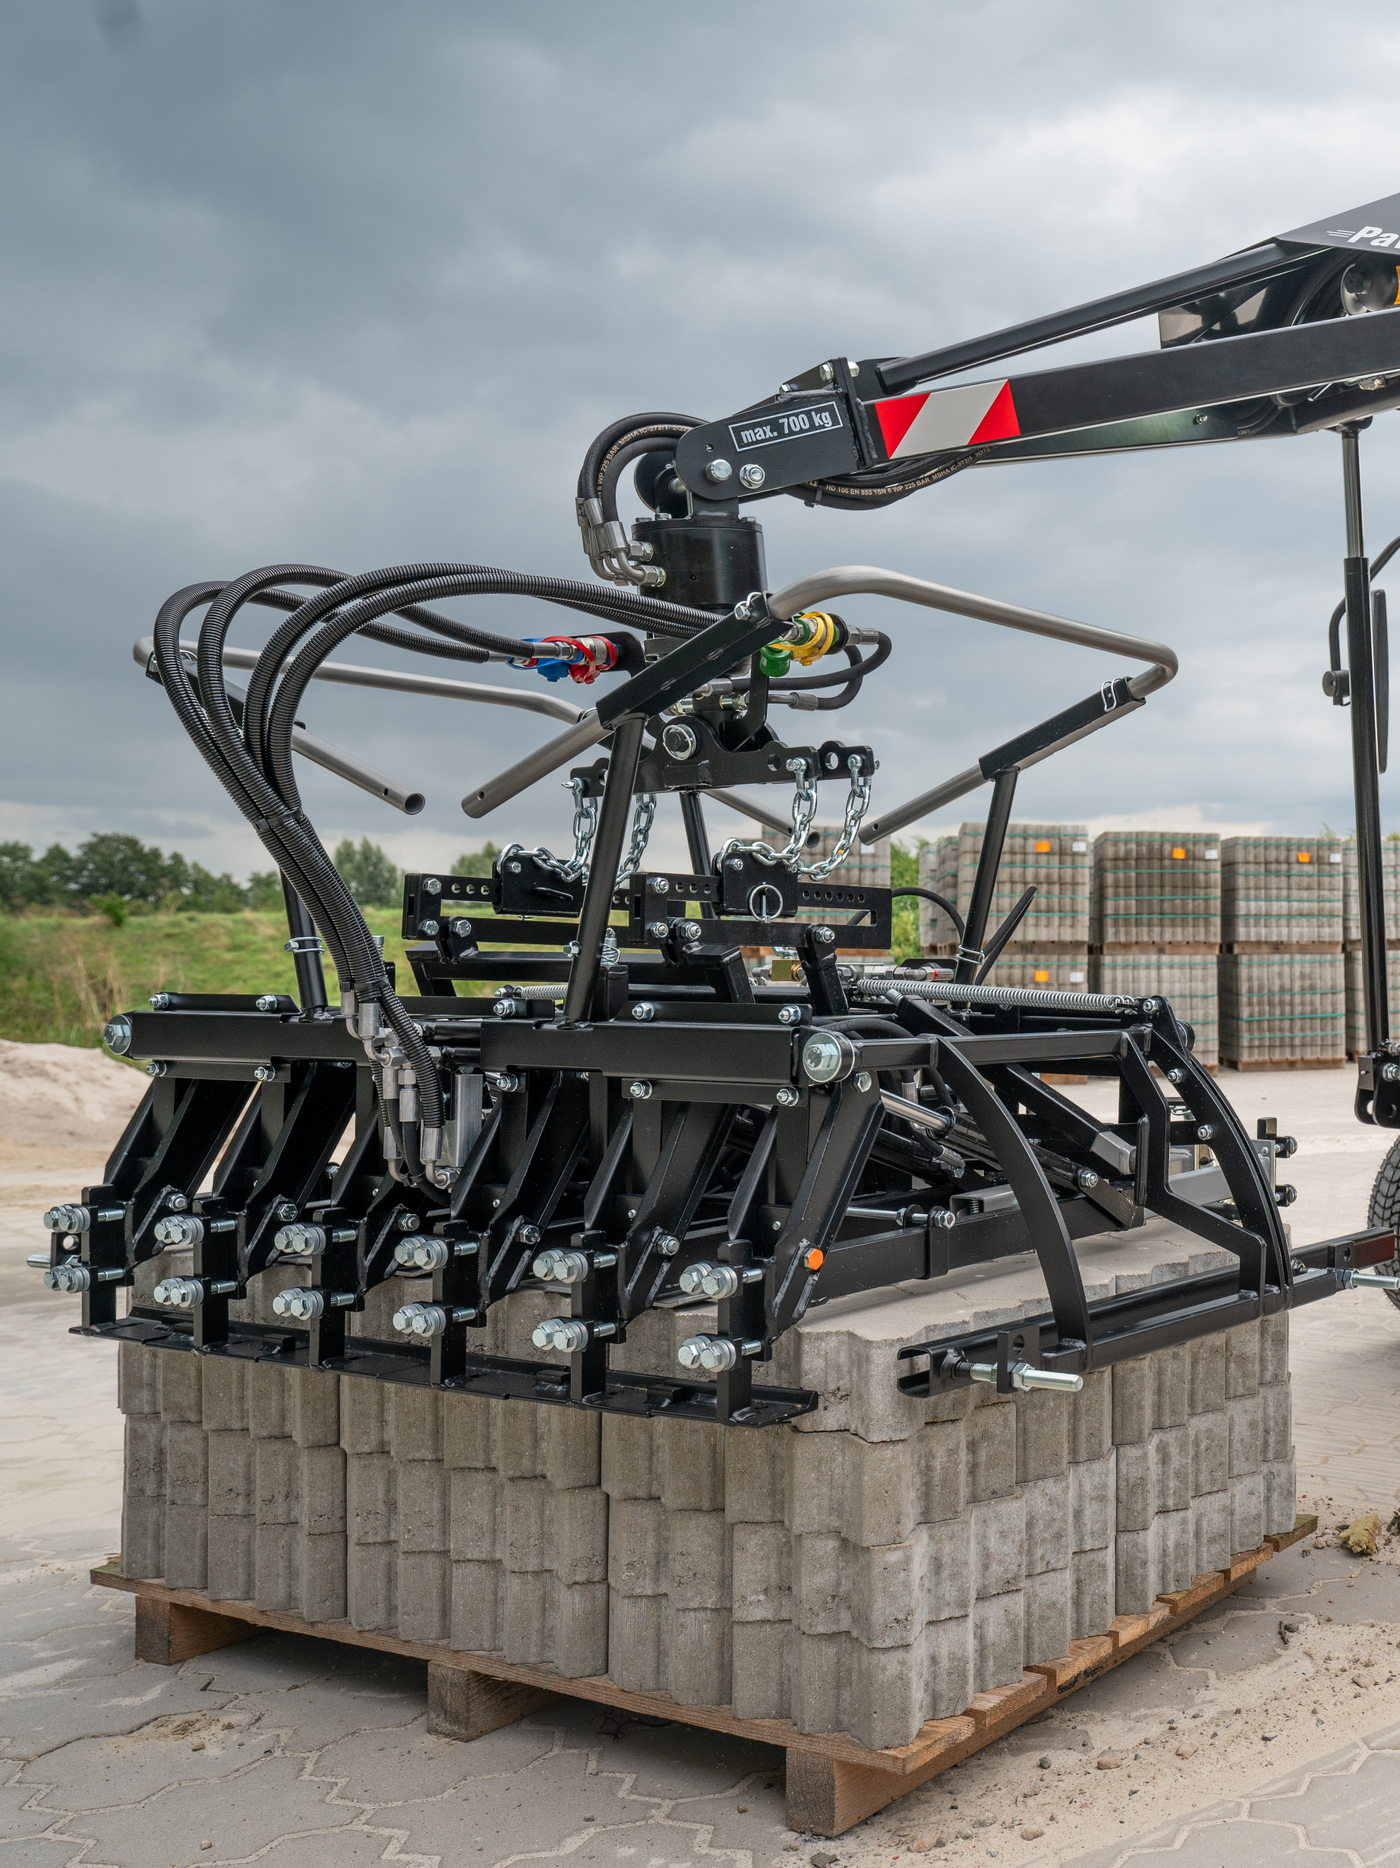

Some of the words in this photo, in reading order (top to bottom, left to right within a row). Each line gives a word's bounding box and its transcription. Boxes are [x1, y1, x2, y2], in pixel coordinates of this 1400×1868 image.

[740, 423, 778, 444] max.
[779, 414, 810, 434] 700
[812, 409, 833, 428] kg
[601, 460, 610, 473] 225
[606, 445, 620, 460] BAR
[619, 431, 639, 446] MSHA
[892, 485, 904, 493] WP
[904, 482, 916, 490] 225
[916, 477, 931, 487] BAR
[931, 468, 951, 481] MSHA
